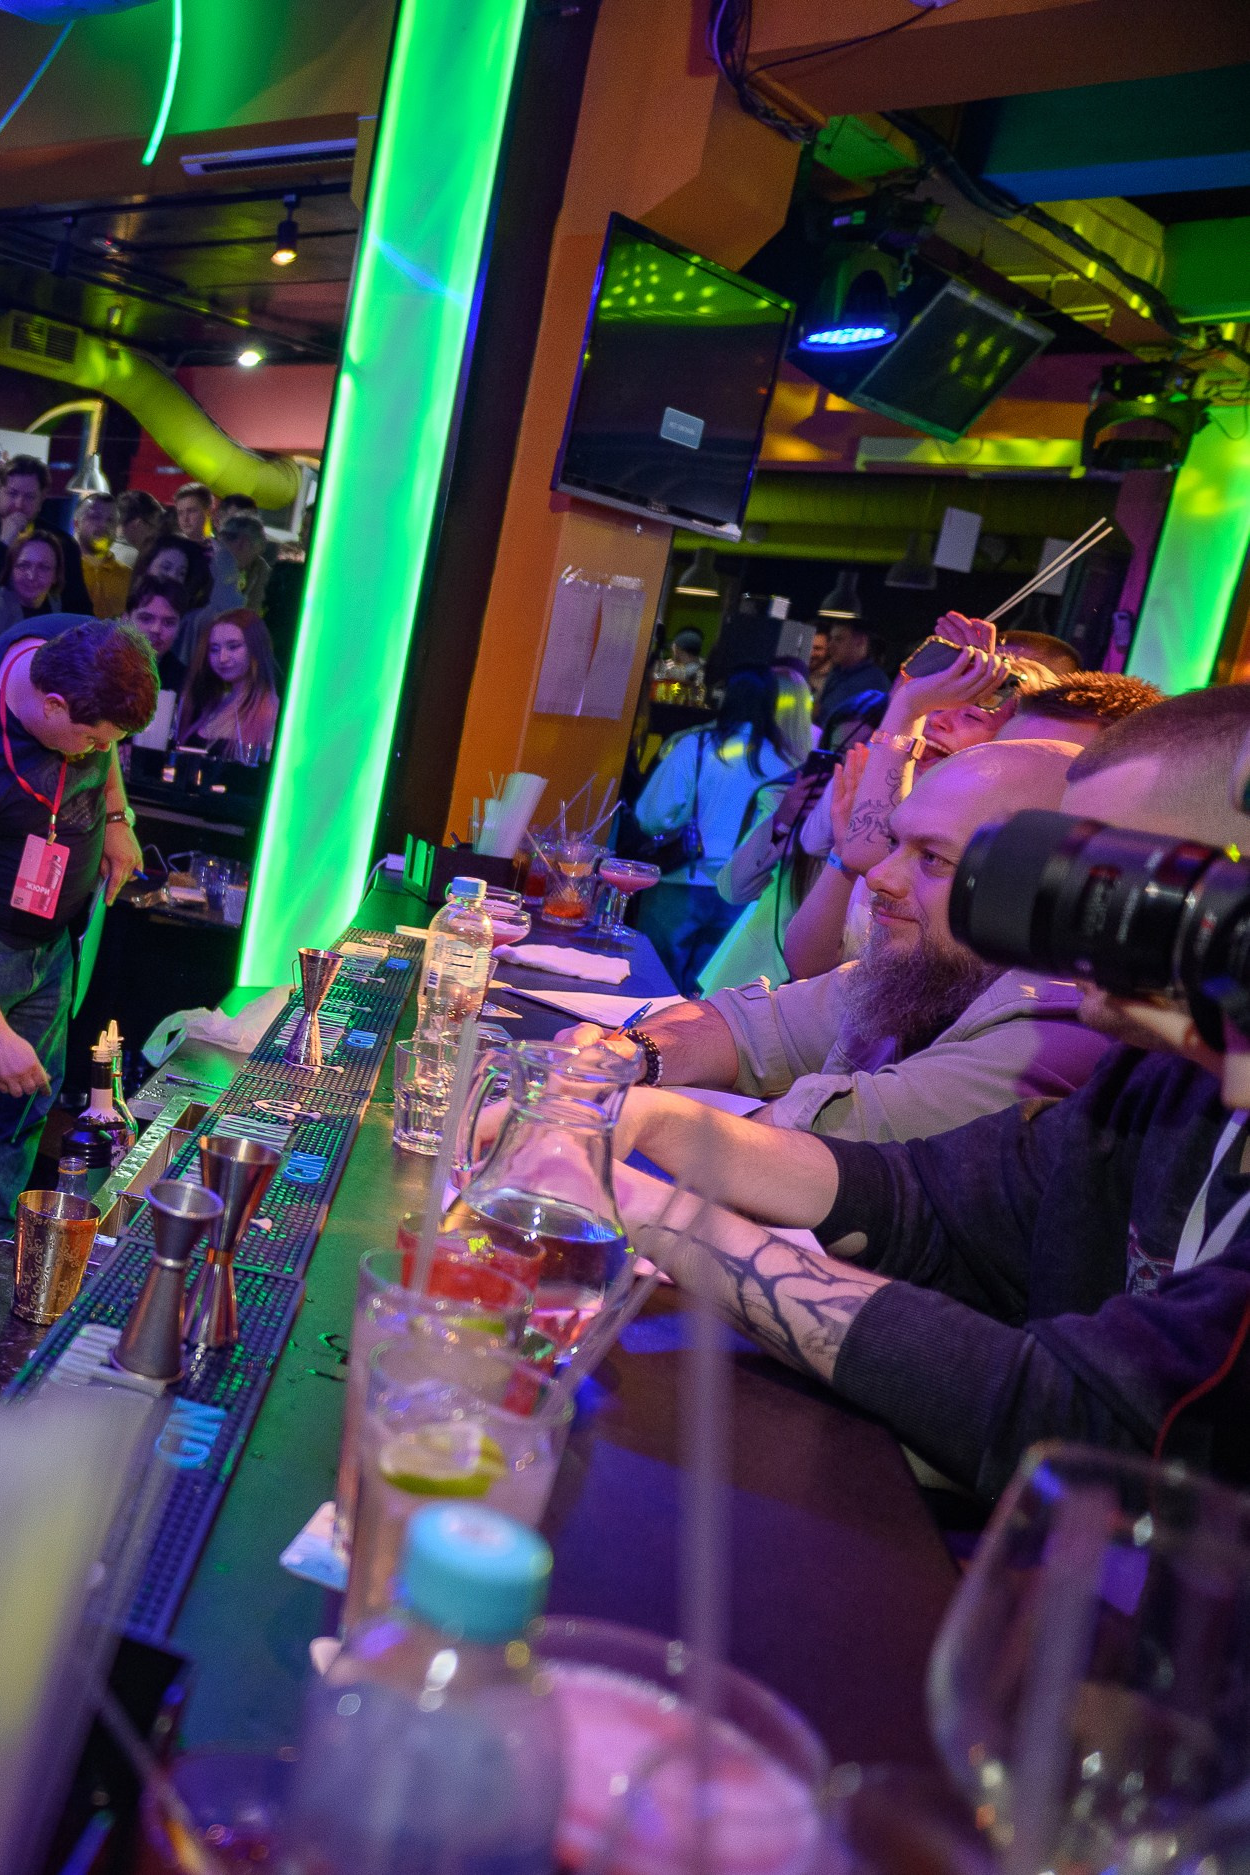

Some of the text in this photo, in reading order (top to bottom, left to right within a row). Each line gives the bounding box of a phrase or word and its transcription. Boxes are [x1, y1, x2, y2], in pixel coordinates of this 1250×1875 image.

[26, 881, 51, 895] ЖЮРИ
[283, 1149, 328, 1184] GIN
[154, 1395, 227, 1470] GIN
